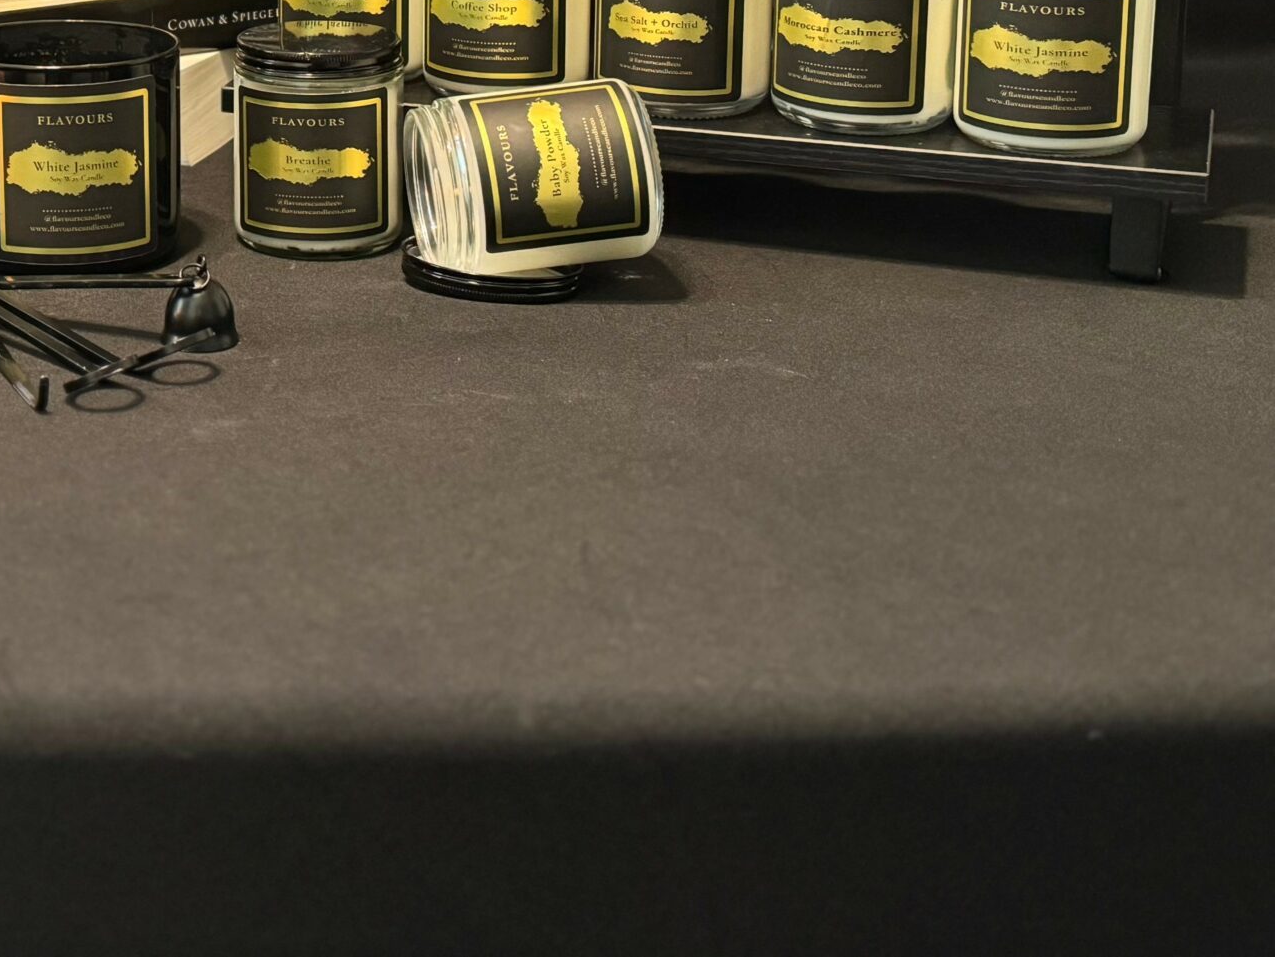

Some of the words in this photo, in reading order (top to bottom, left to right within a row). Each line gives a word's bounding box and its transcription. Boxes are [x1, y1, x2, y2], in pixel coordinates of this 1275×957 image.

[451, 0, 484, 12] Coffee
[488, 3, 517, 15] Shop
[1000, 2, 1085, 15] FLAVOURS
[168, 17, 214, 31] COWAN
[219, 14, 227, 24] &
[615, 13, 628, 23] Sea
[631, 15, 649, 26] Salt
[651, 19, 659, 27] +
[662, 18, 698, 29] Orchid
[784, 17, 829, 33] Moroccan
[834, 25, 897, 36] Cashmere
[994, 40, 1031, 56] White
[1035, 46, 1088, 59] Jasmine
[37, 113, 113, 126] FLAVOURS
[272, 117, 345, 127] FLAVOURS
[540, 120, 556, 162] Powder
[33, 161, 70, 172] White
[74, 159, 119, 172] Jasmine
[286, 156, 331, 166] Breathe
[497, 125, 519, 201] FLAVOURS
[550, 166, 561, 196] Baby
